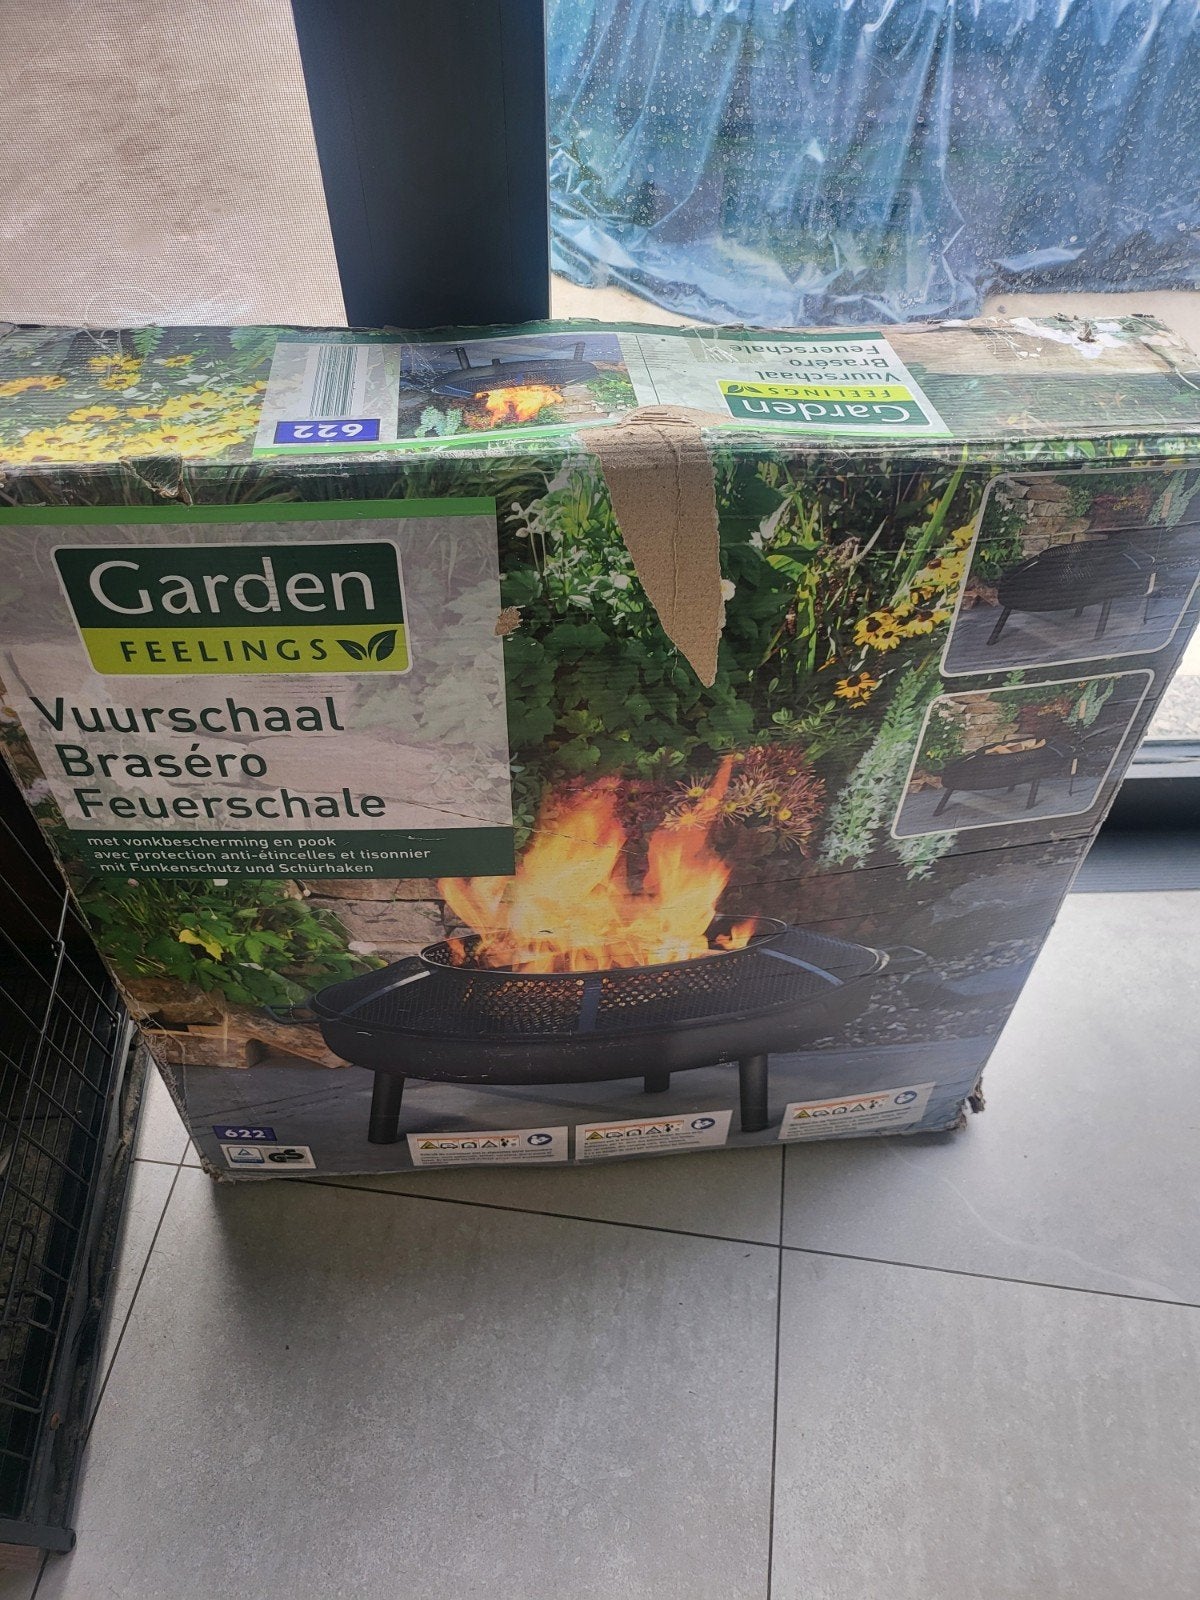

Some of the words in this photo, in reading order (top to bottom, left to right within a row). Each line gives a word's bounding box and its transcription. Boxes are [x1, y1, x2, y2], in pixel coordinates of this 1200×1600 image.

[729, 344, 880, 355] Feuerschale
[790, 358, 889, 369] Braséro
[755, 370, 902, 382] Vuurschaal
[768, 387, 891, 397] FEELINGS
[743, 399, 911, 423] Garden
[293, 423, 363, 439] 622
[89, 556, 376, 615] Garden
[120, 638, 328, 663] FEELINGS
[29, 697, 345, 733] Vuurschaal
[55, 743, 268, 778] Braséro
[75, 787, 387, 819] Feuerschale
[87, 837, 120, 846] met
[123, 837, 269, 849] vonkbescherming
[273, 838, 297, 846] en
[298, 837, 337, 849] pook
[94, 851, 130, 860] avec
[134, 850, 217, 861] protection
[221, 850, 336, 860] anti-étincelles
[340, 850, 356, 860] et
[360, 849, 431, 859] tisonnier
[100, 863, 127, 872] mit
[130, 862, 242, 873] Funkenschutz
[245, 863, 275, 873] und
[279, 863, 374, 873] Schürhaken
[224, 1129, 266, 1138] 622
[268, 1149, 305, 1163] GS
